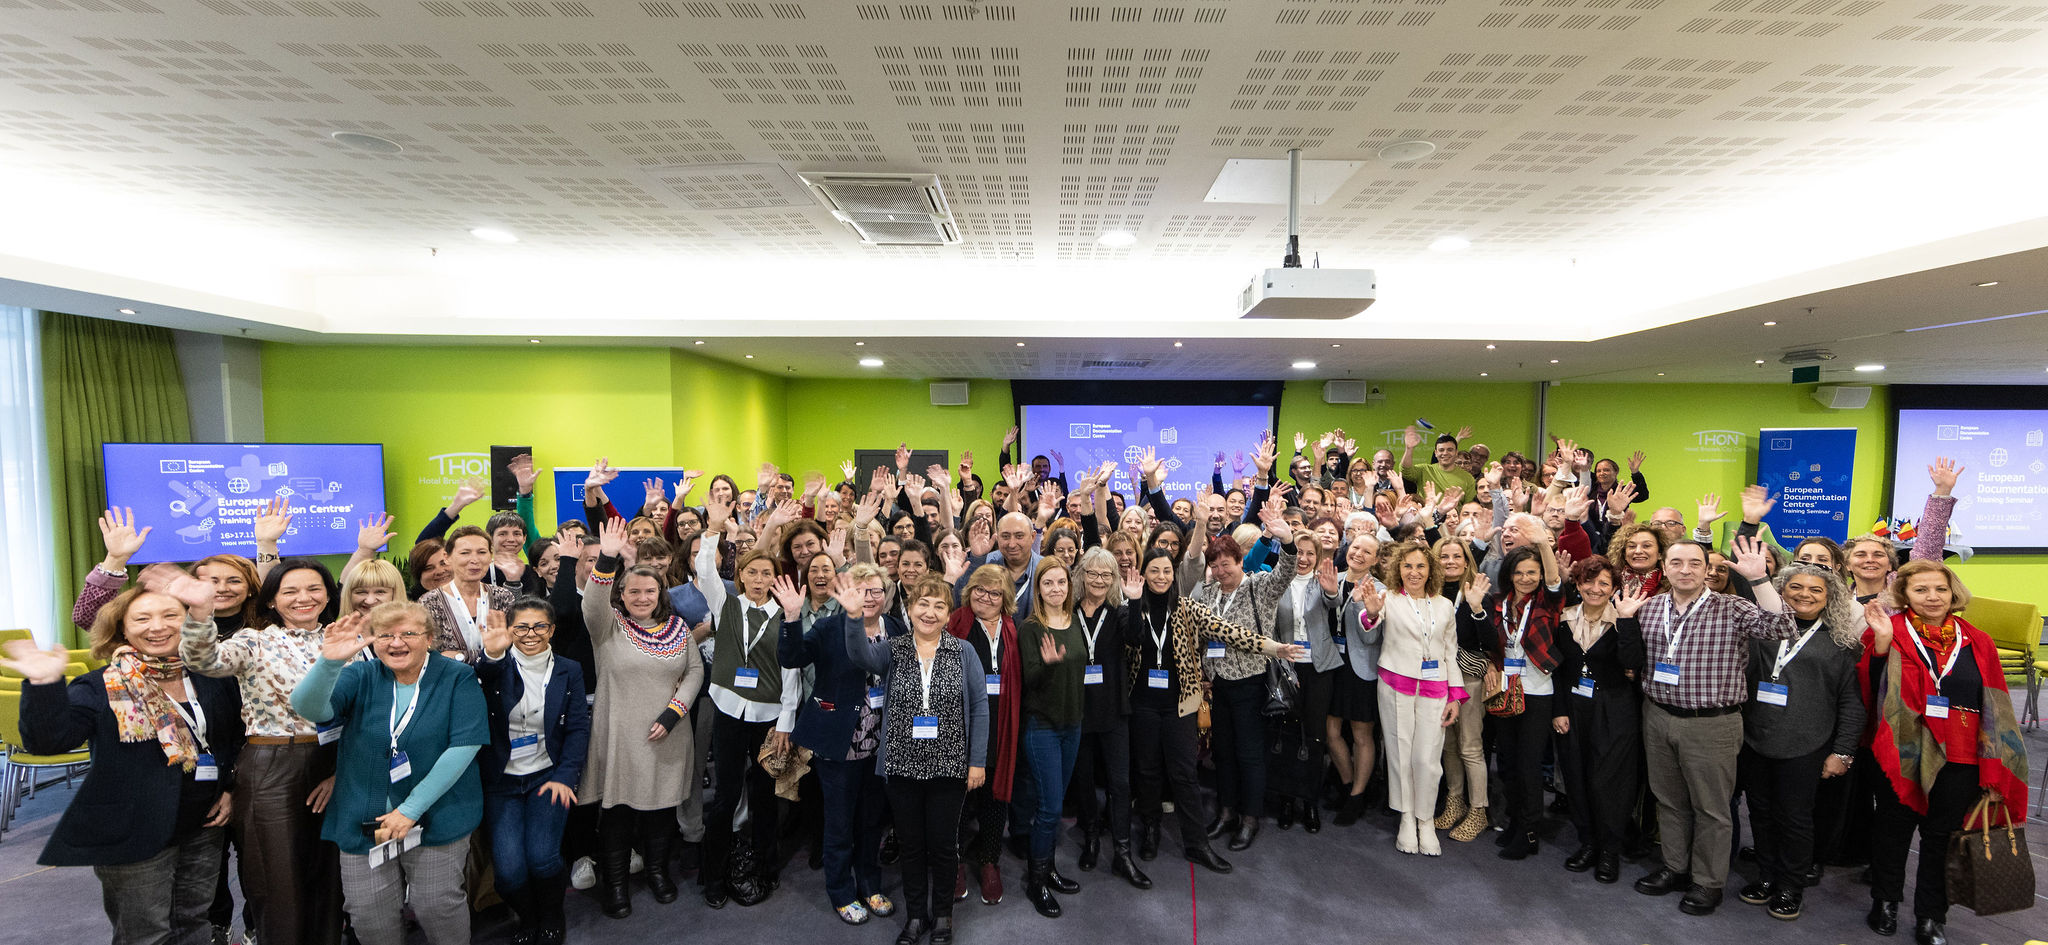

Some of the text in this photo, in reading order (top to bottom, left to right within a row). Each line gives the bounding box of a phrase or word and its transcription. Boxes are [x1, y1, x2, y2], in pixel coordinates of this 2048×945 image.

[1380, 429, 1435, 445] THN
[1692, 430, 1745, 446] THON
[1979, 472, 2025, 483] European
[1114, 481, 1192, 491] Doctation
[1977, 484, 2048, 494] Documentatio
